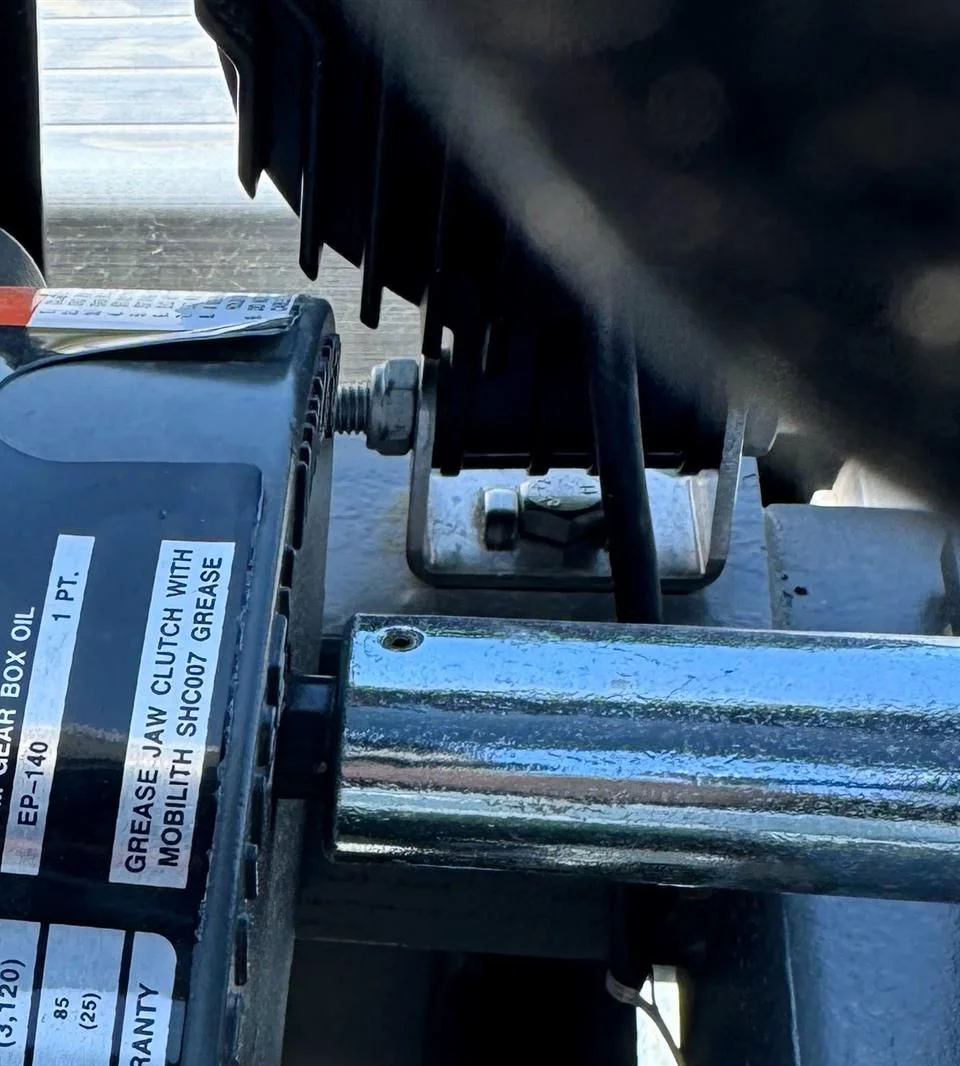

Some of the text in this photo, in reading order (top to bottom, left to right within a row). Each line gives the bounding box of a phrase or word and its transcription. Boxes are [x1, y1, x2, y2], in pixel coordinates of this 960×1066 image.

[11, 606, 36, 642] OIL
[0, 650, 27, 699] BOX
[17, 571, 80, 827] EP-140 1 PT.
[125, 548, 194, 874] GREASE JAW CLUTCH WITH
[158, 556, 222, 868] MOBILITH SHC007 GREASE
[54, 997, 70, 1020] 85
[79, 993, 102, 1030] (25)
